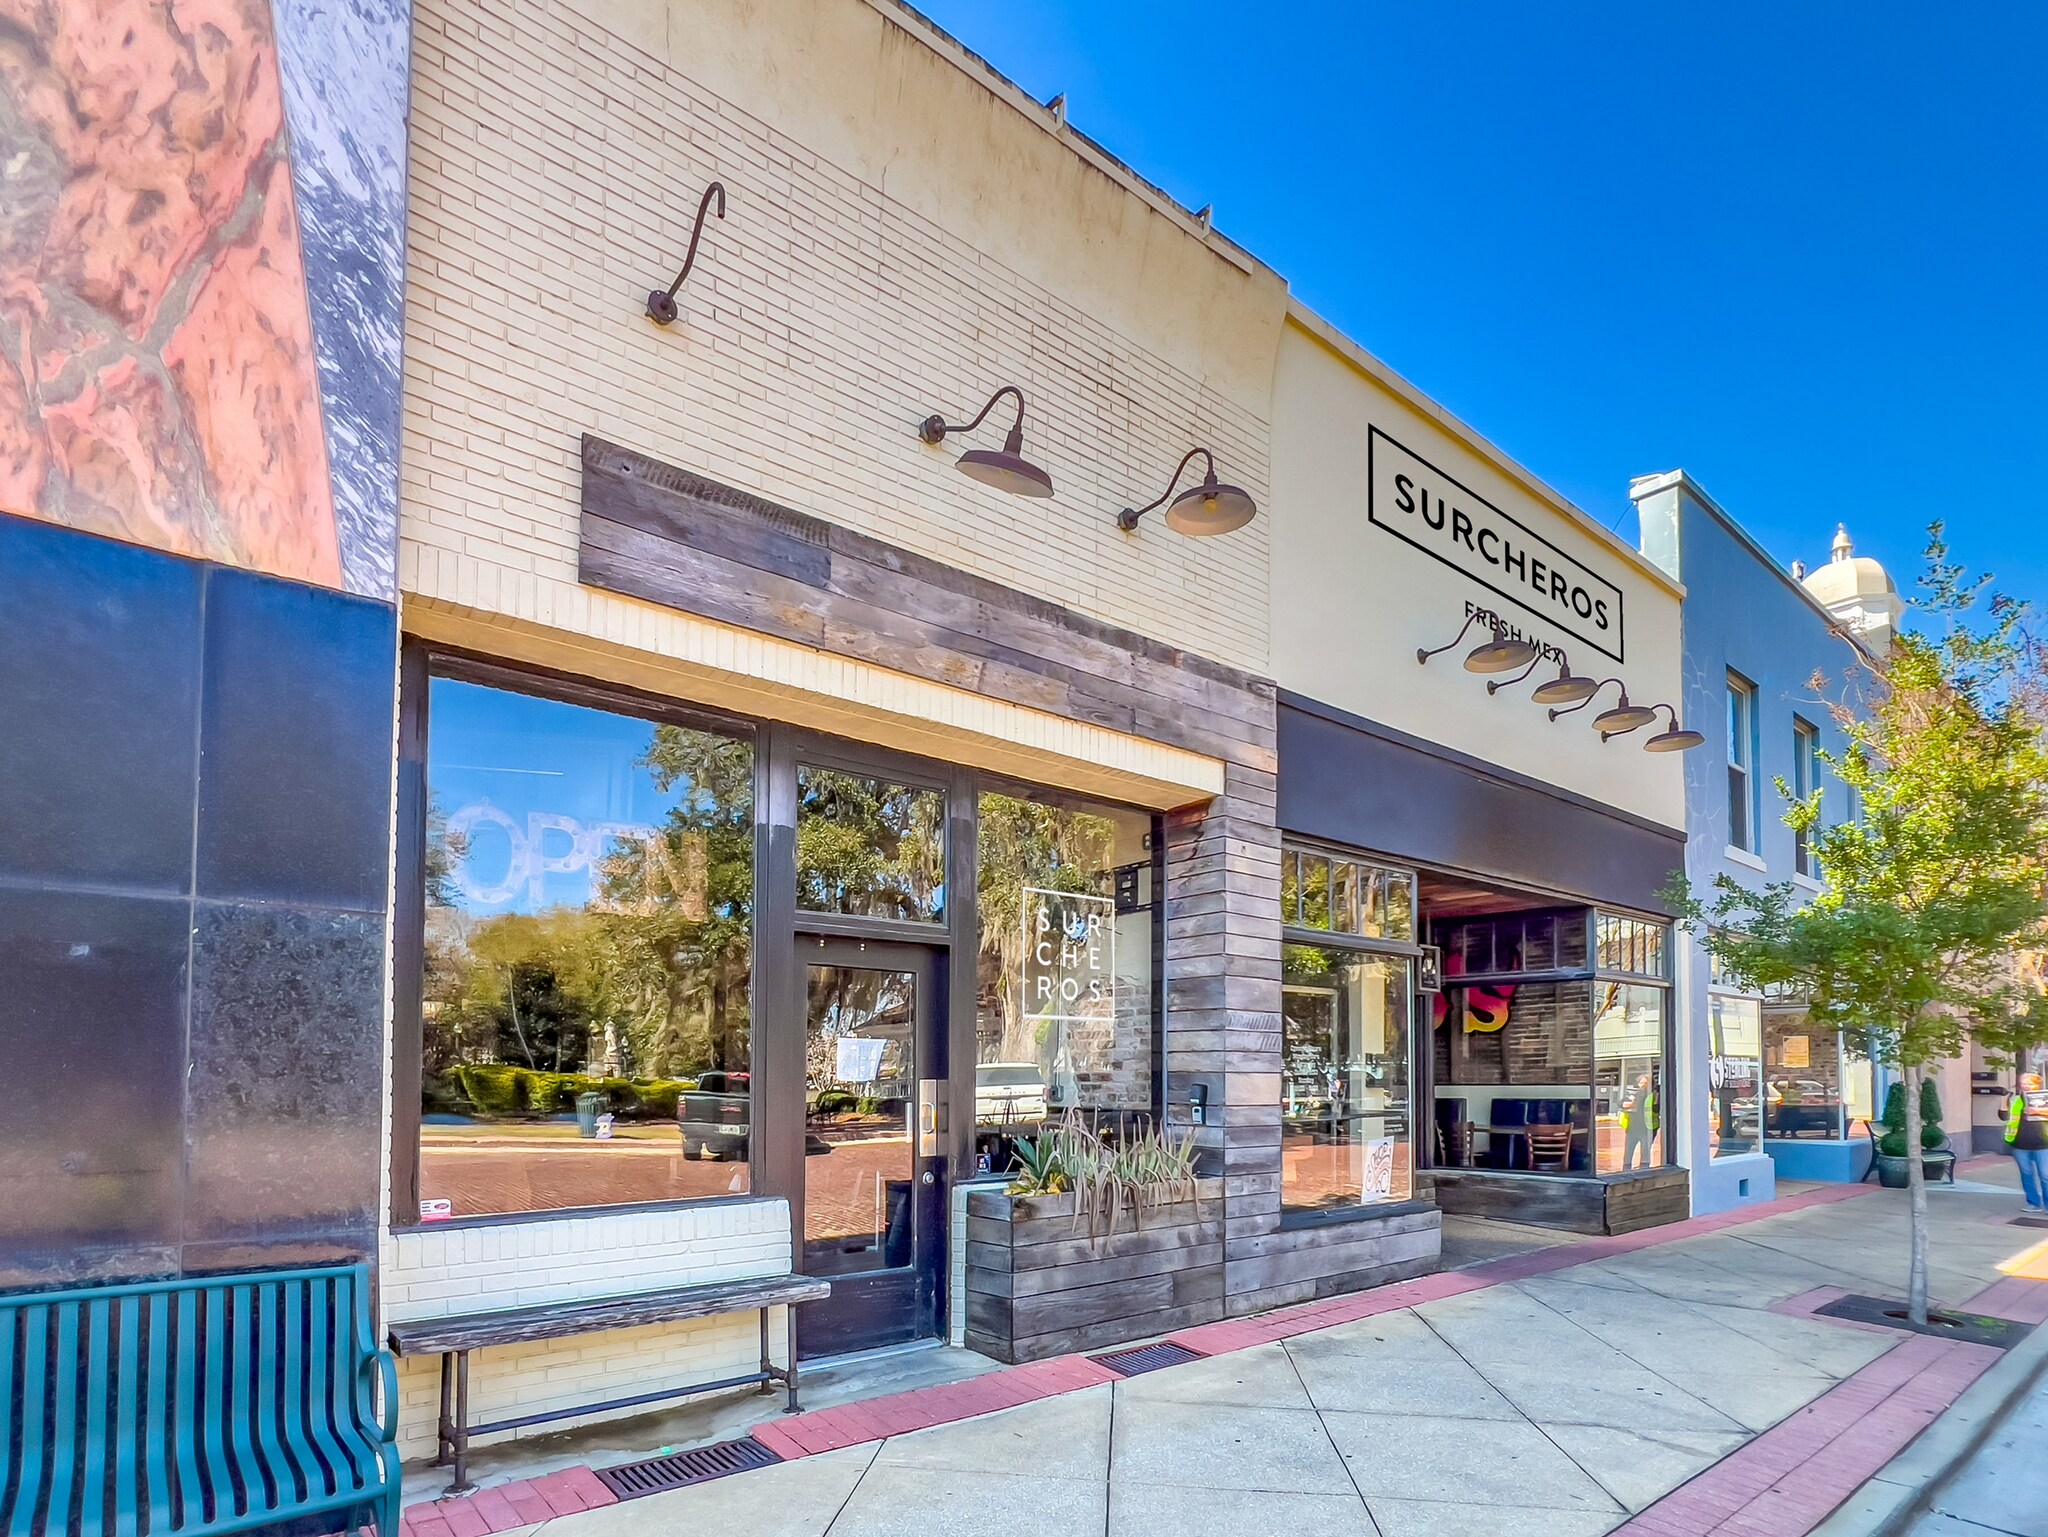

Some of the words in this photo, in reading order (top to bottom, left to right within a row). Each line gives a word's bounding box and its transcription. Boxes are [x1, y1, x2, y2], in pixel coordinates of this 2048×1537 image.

[1394, 473, 1609, 631] SURCHEROS
[1464, 600, 1522, 642] FRESH
[1528, 634, 1563, 666] MEX
[445, 803, 708, 923] OPEN
[1037, 907, 1102, 938] SUR
[1035, 942, 1101, 970] CHE
[1036, 976, 1101, 1003] ROS
